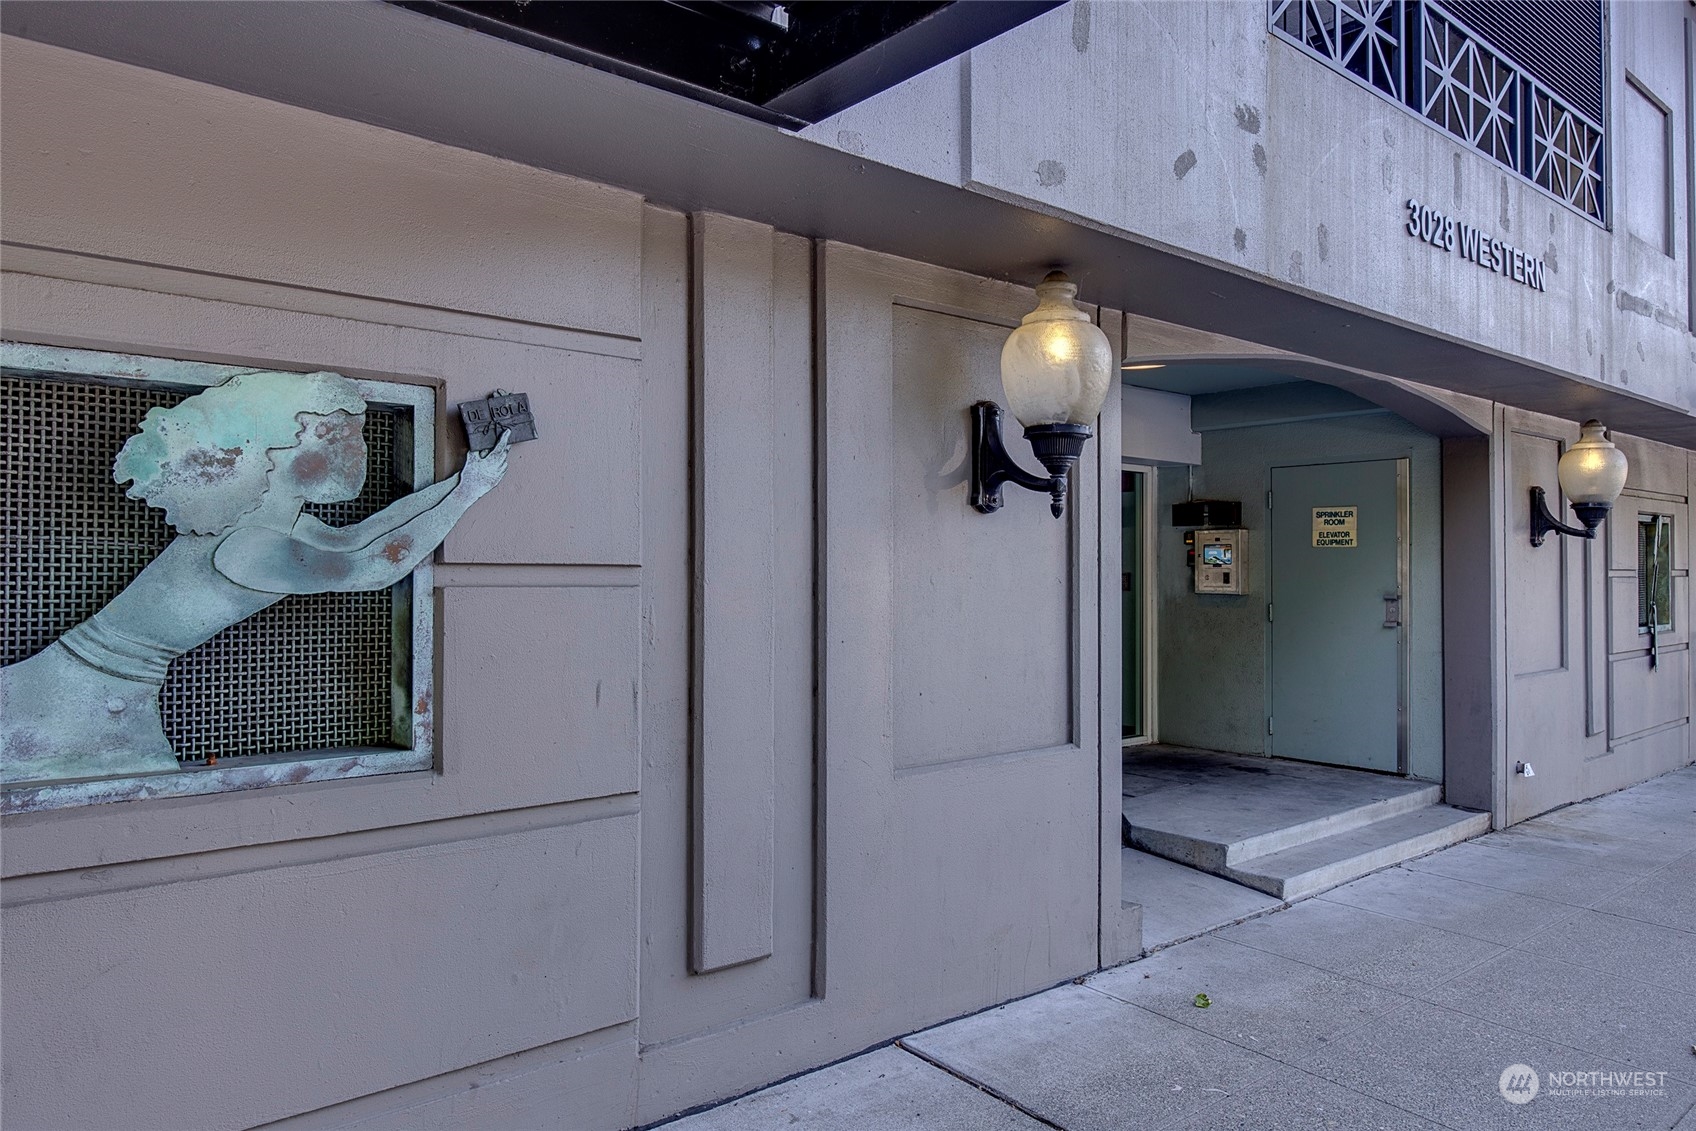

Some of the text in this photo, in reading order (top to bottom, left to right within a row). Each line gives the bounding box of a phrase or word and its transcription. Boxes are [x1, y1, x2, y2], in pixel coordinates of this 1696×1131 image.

[1406, 198, 1546, 293] 3028 WESTERN
[467, 409, 484, 423] DE
[1315, 511, 1353, 519] SPRINKLER
[1319, 531, 1350, 539] ELEVATOR
